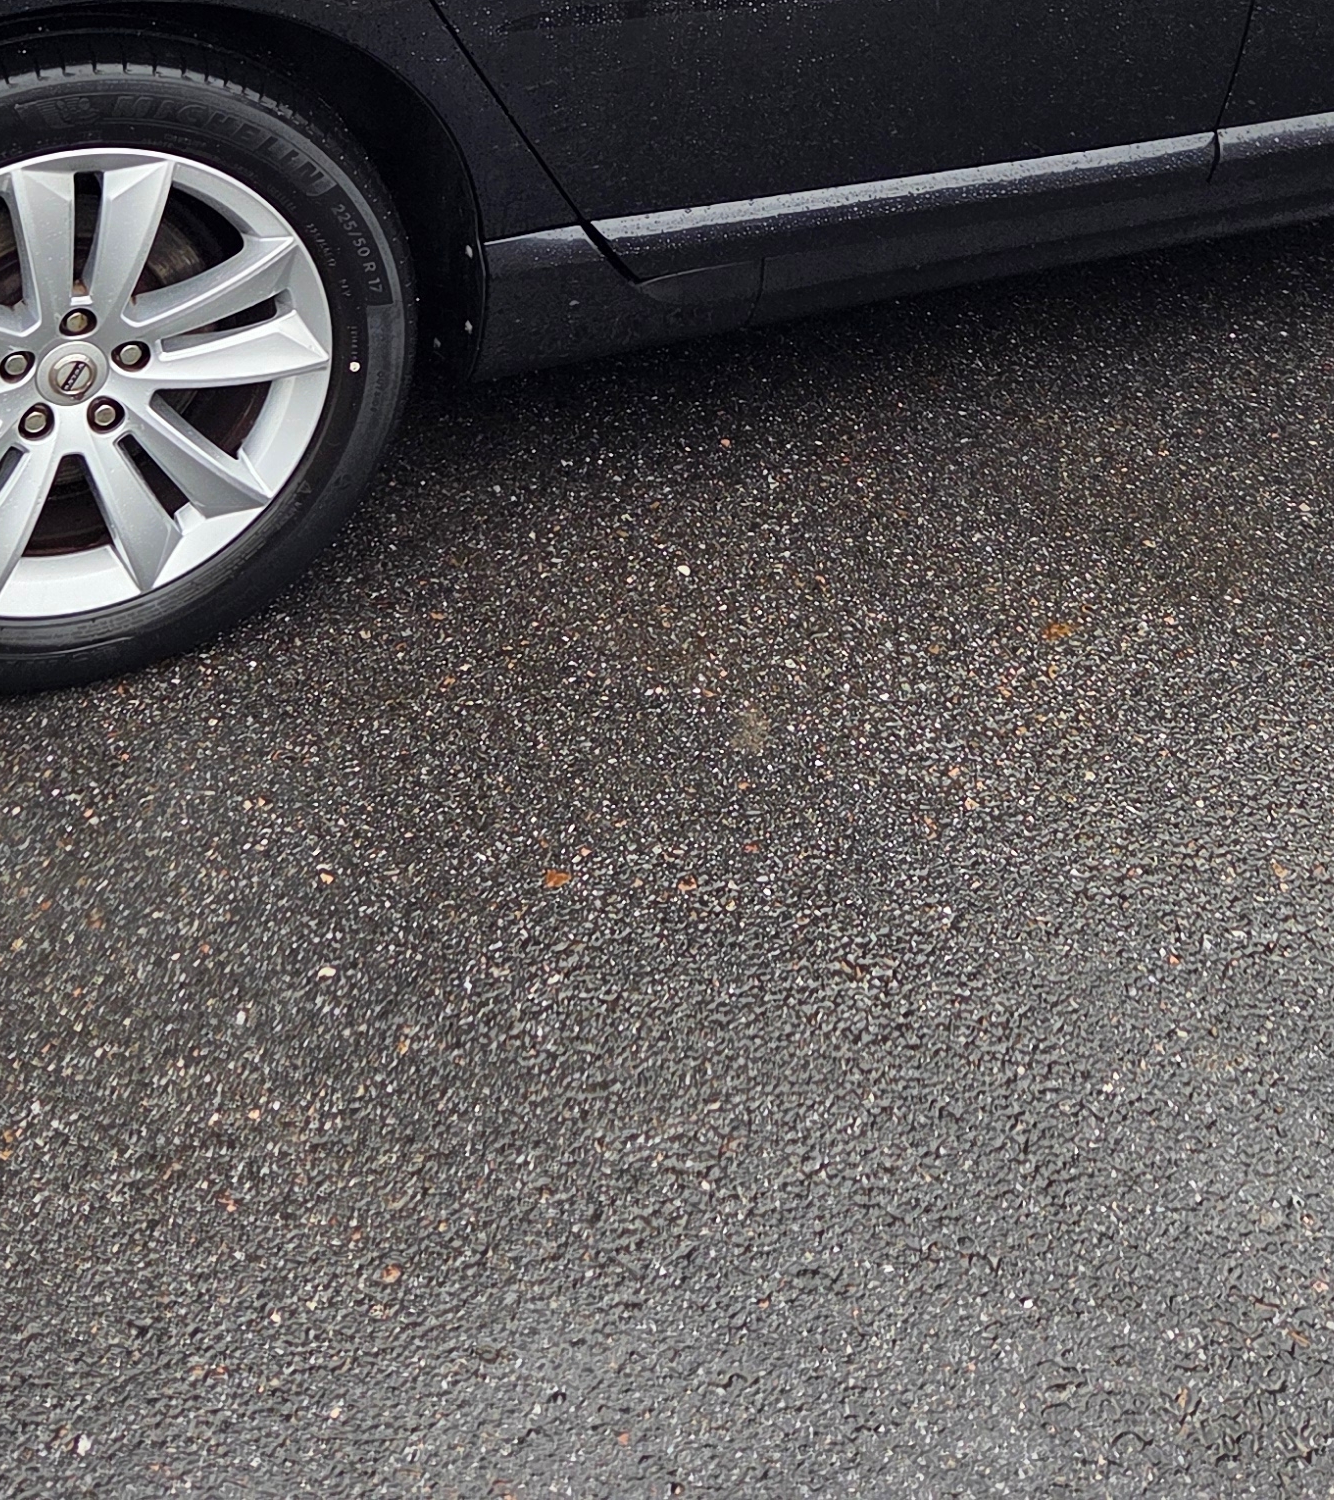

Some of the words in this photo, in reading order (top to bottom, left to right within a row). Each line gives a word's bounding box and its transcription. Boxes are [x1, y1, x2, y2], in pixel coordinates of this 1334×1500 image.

[113, 96, 325, 183] MICHELIN
[331, 203, 371, 257] 225/50
[364, 261, 377, 273] R
[368, 277, 383, 294] 17
